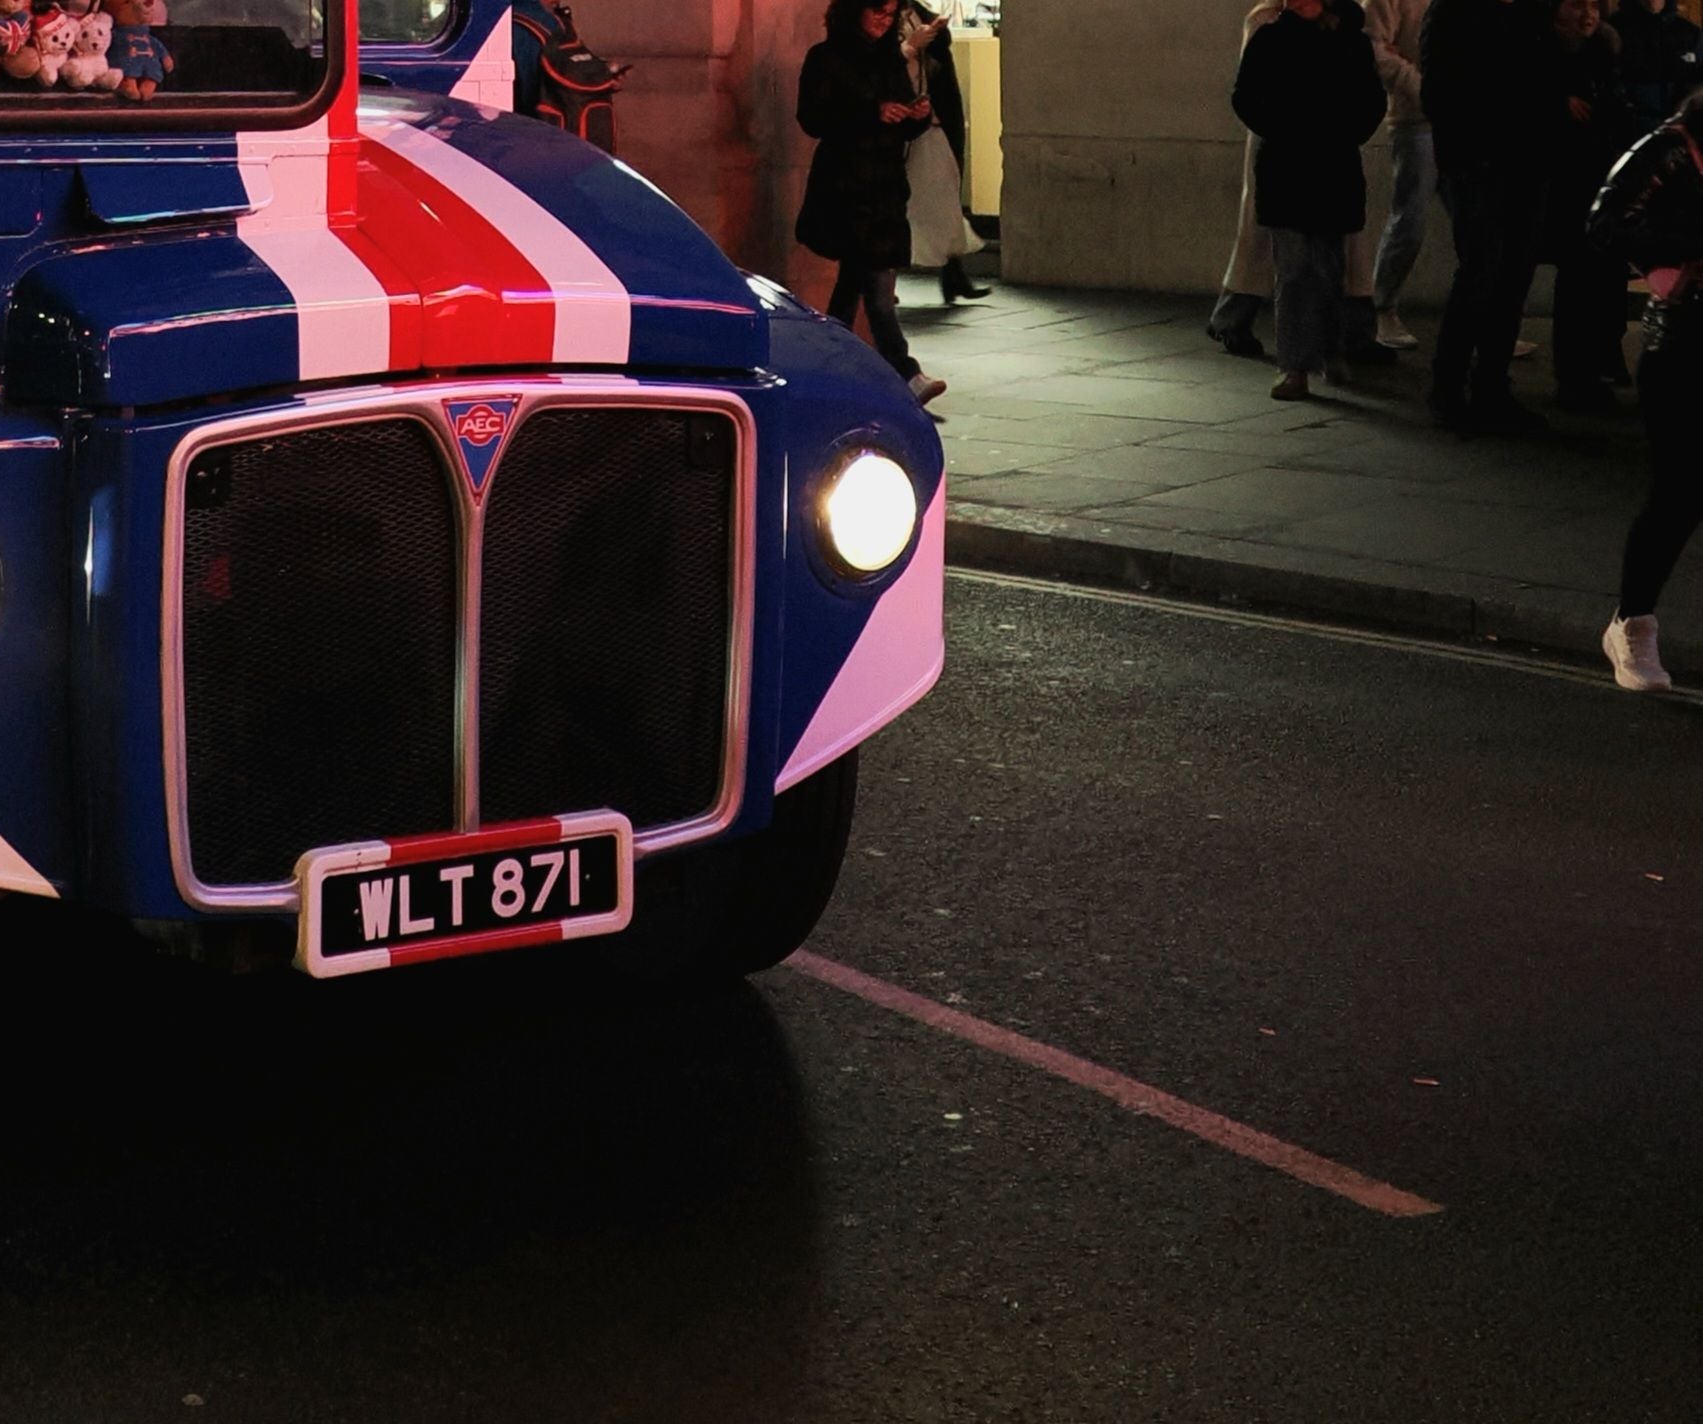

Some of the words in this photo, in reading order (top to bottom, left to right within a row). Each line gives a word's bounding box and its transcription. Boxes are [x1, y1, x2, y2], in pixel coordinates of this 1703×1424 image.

[459, 415, 502, 435] AEC
[358, 863, 475, 942] WLT
[491, 848, 581, 919] 871
